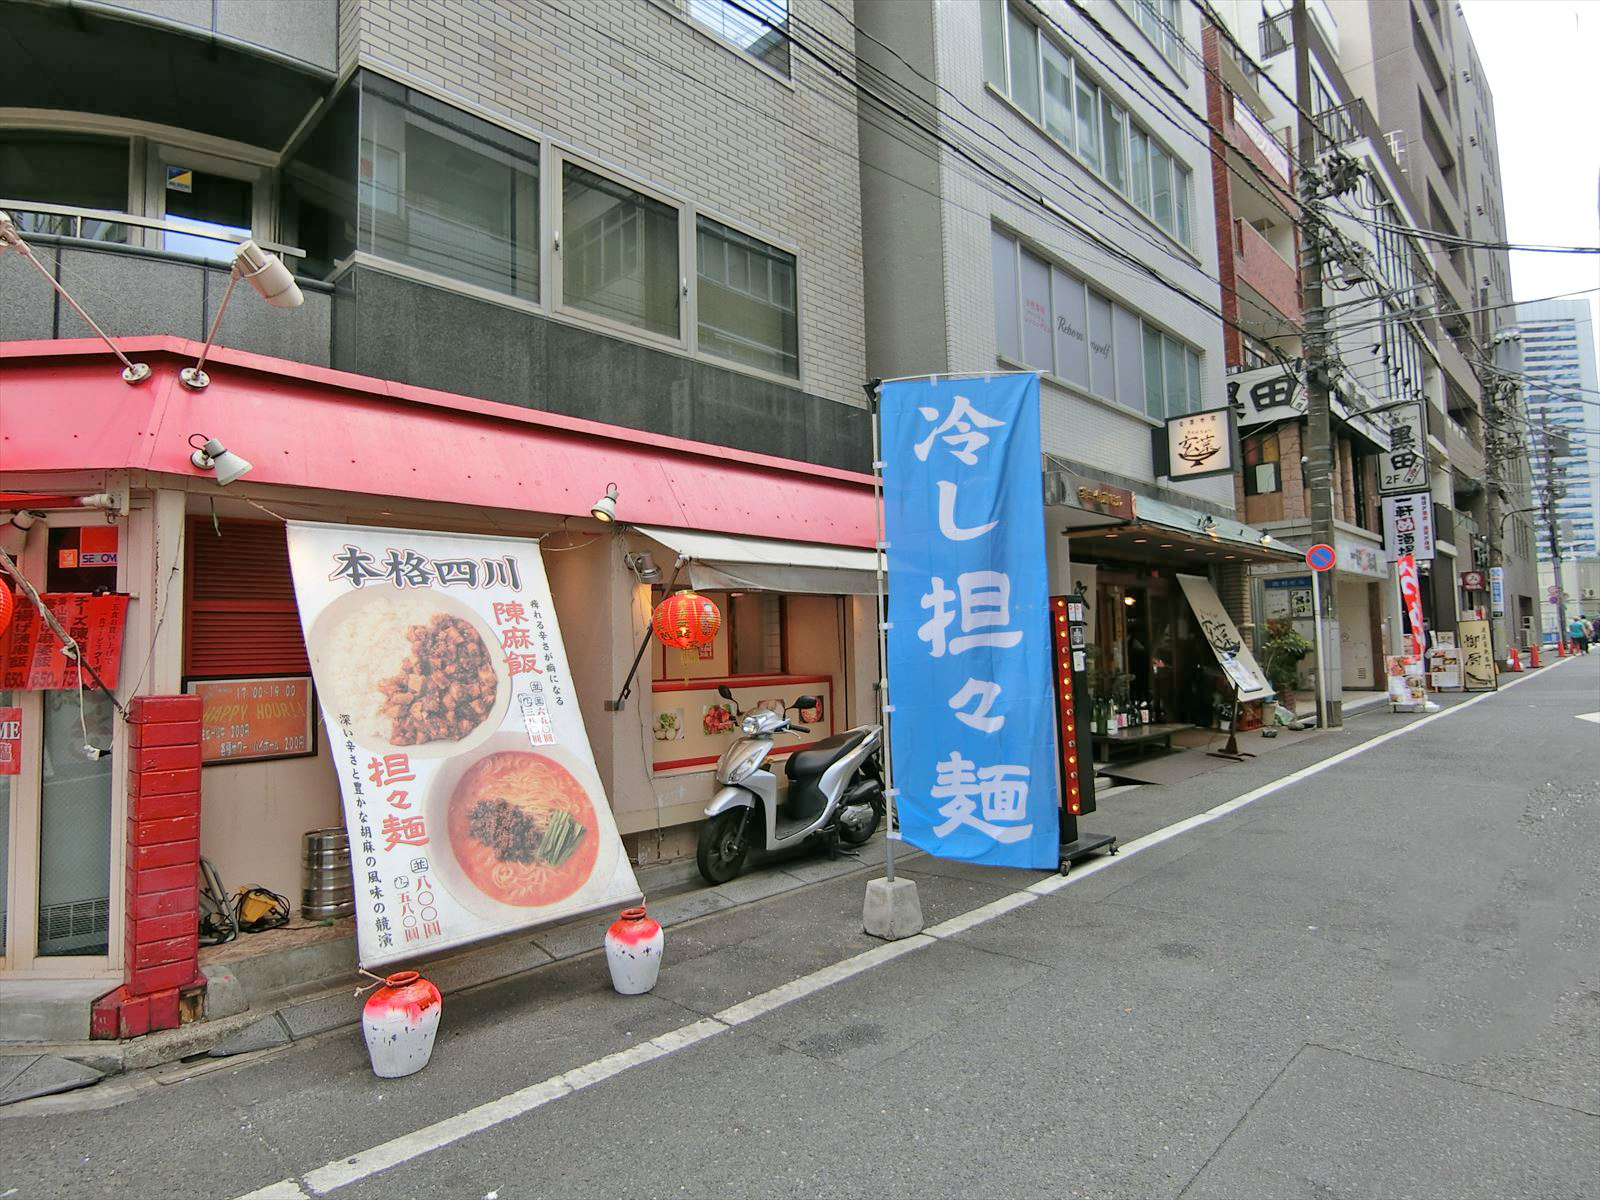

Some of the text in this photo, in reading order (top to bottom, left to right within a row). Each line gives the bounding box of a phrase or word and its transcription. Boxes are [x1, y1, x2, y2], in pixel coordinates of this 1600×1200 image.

[1057, 316, 1083, 341] Reborn
[1391, 425, 1417, 470] 黒田
[1385, 474, 1400, 485] 2F
[329, 543, 525, 592] 本格四川
[493, 601, 543, 677] 陳麻飯
[912, 394, 1035, 844] 冷し担々麺
[203, 704, 248, 723] HAPPY
[368, 752, 431, 852] 担々麺
